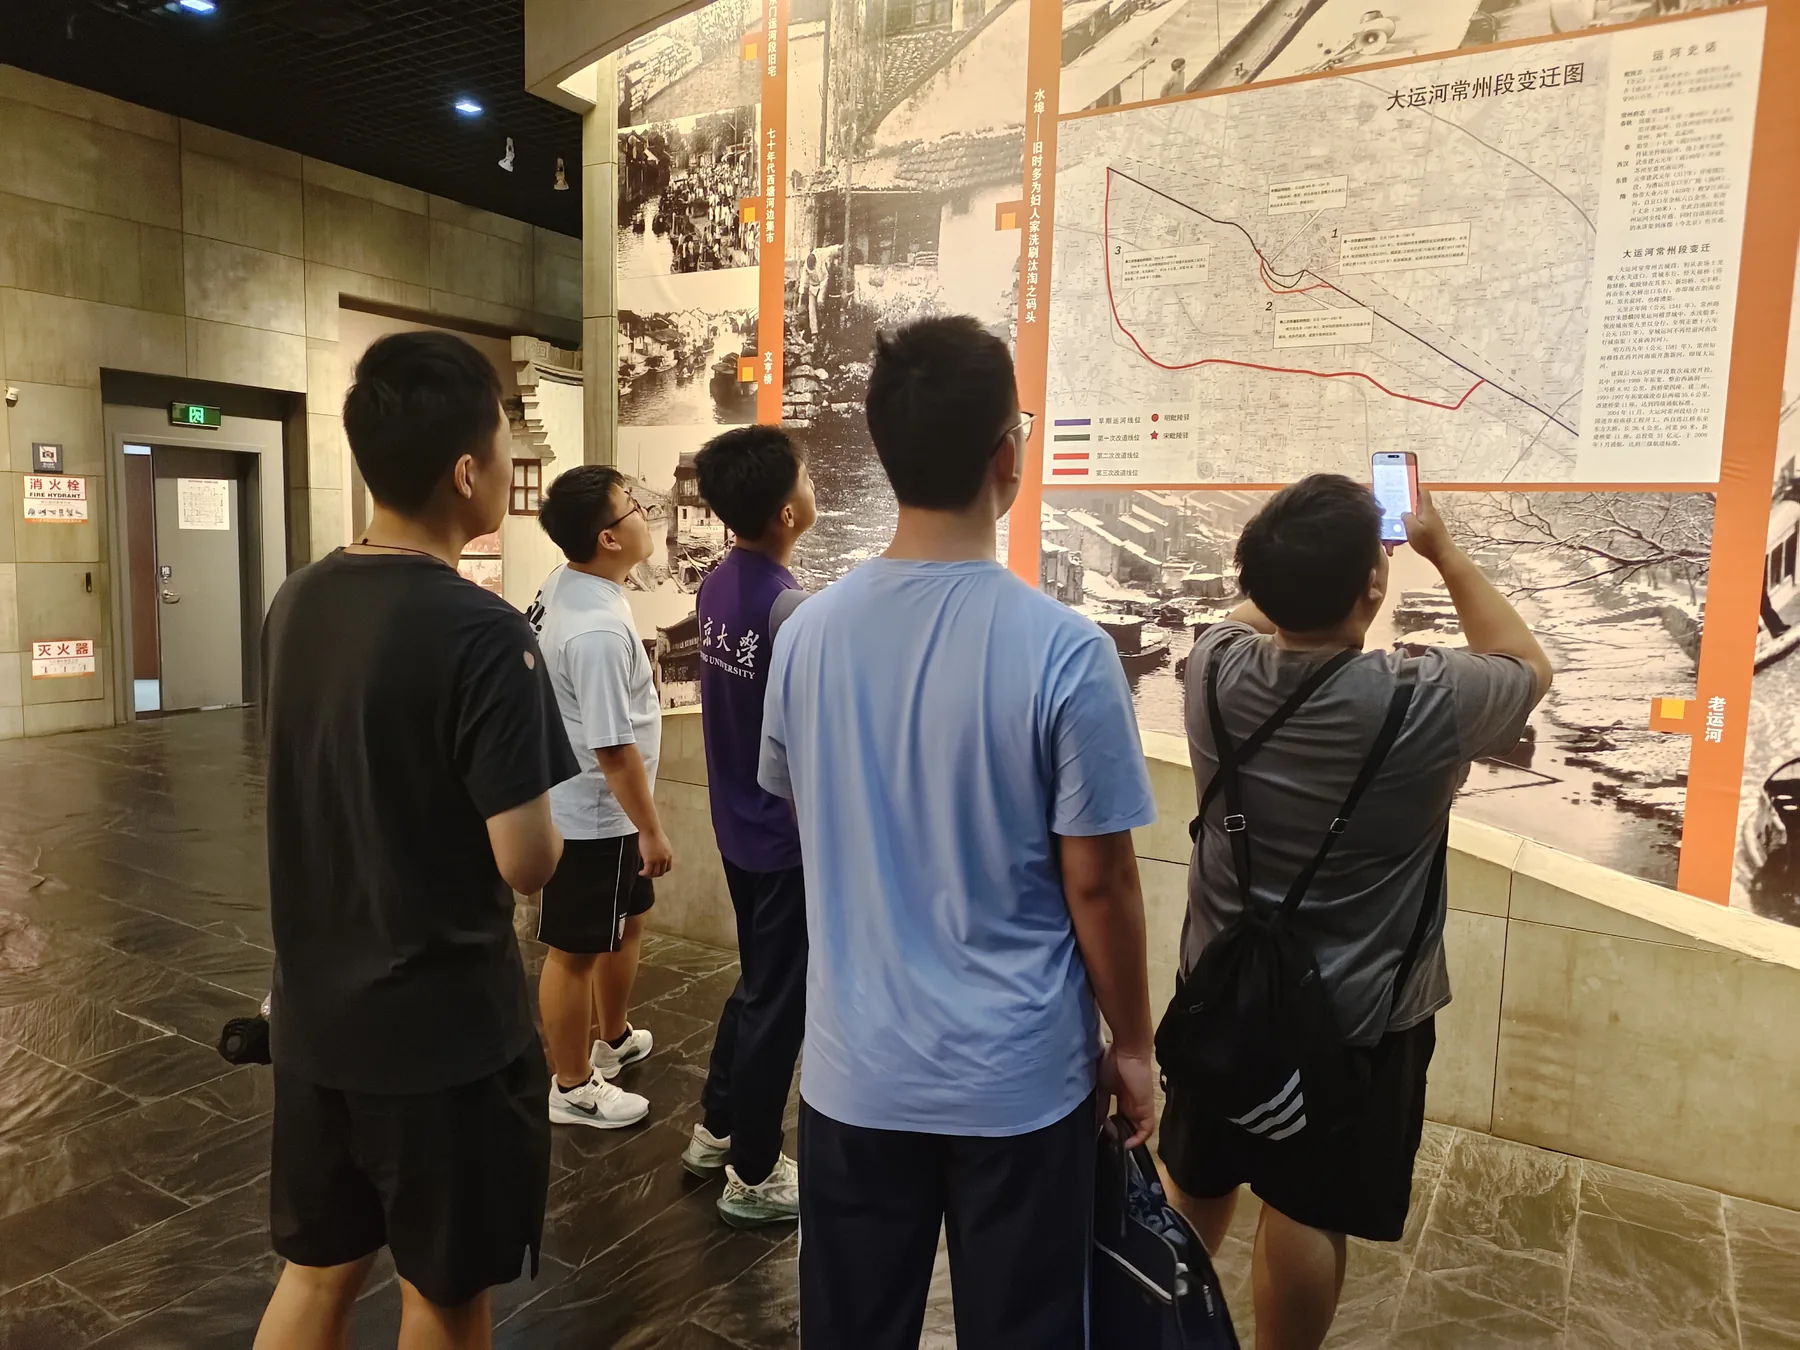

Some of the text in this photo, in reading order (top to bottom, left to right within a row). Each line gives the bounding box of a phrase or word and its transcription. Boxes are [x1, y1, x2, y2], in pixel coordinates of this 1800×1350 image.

[1386, 62, 1585, 111] 大运河常州段变迁图
[1331, 228, 1339, 239] 1
[1114, 245, 1122, 255] 3
[1623, 243, 1711, 259] 大运河常州段变迁
[1265, 301, 1273, 311] 2
[763, 350, 773, 385] 文亨桥
[1097, 414, 1190, 425] 早期运河线位 明毗陵驿
[1097, 434, 1141, 442] 第一次改道线位
[1096, 451, 1140, 460] 第二次改道线位
[1095, 469, 1139, 477] 第三次改道线位
[30, 478, 80, 491] 消火栓
[38, 643, 88, 657] 灭火器
[709, 655, 756, 680] UNIVERSITY
[1704, 695, 1726, 743] 老运河
